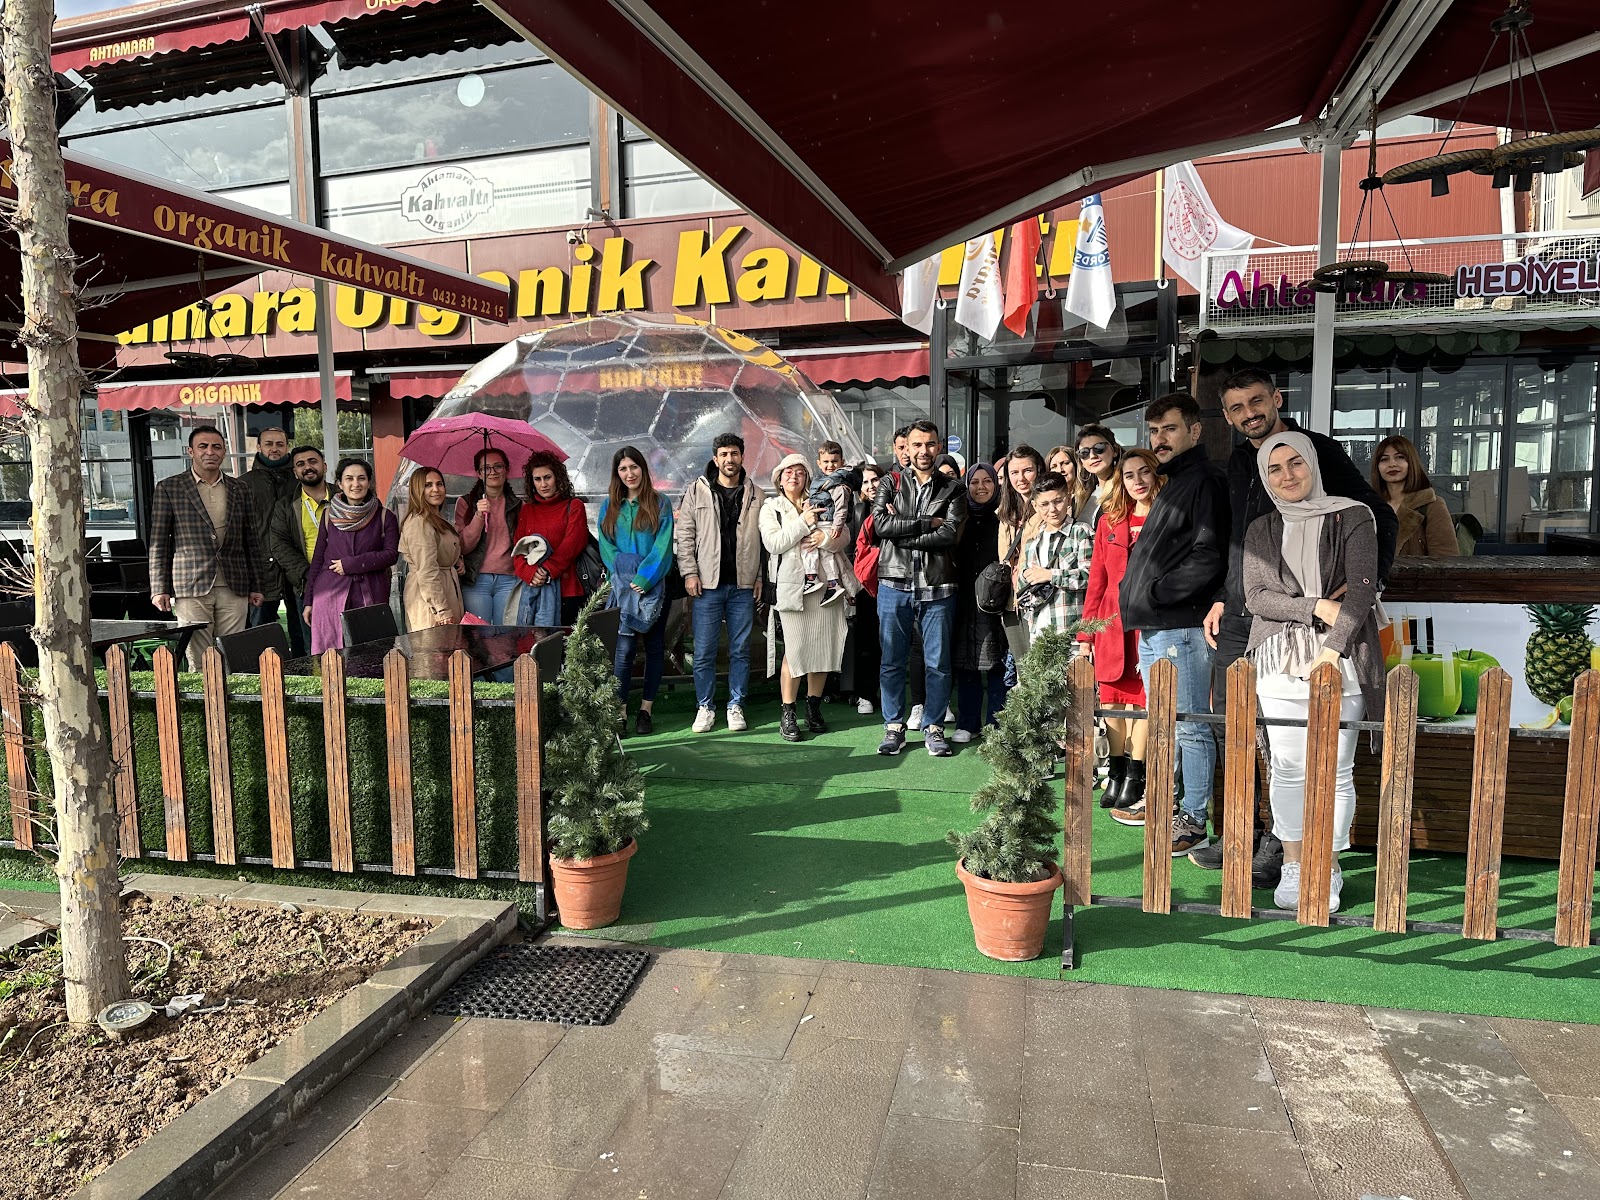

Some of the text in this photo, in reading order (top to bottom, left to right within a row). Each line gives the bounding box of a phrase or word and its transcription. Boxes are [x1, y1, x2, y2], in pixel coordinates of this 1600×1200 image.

[90, 37, 155, 61] AHTAMARA
[421, 172, 473, 192] Ahtamara
[425, 209, 473, 230] Organik
[153, 205, 291, 263] organik
[320, 242, 425, 297] kahvaltı
[432, 287, 456, 305] 0432
[461, 294, 478, 311] 312
[480, 299, 491, 315] 22
[494, 304, 504, 318] 15
[1459, 255, 1600, 295] HEDİYEL
